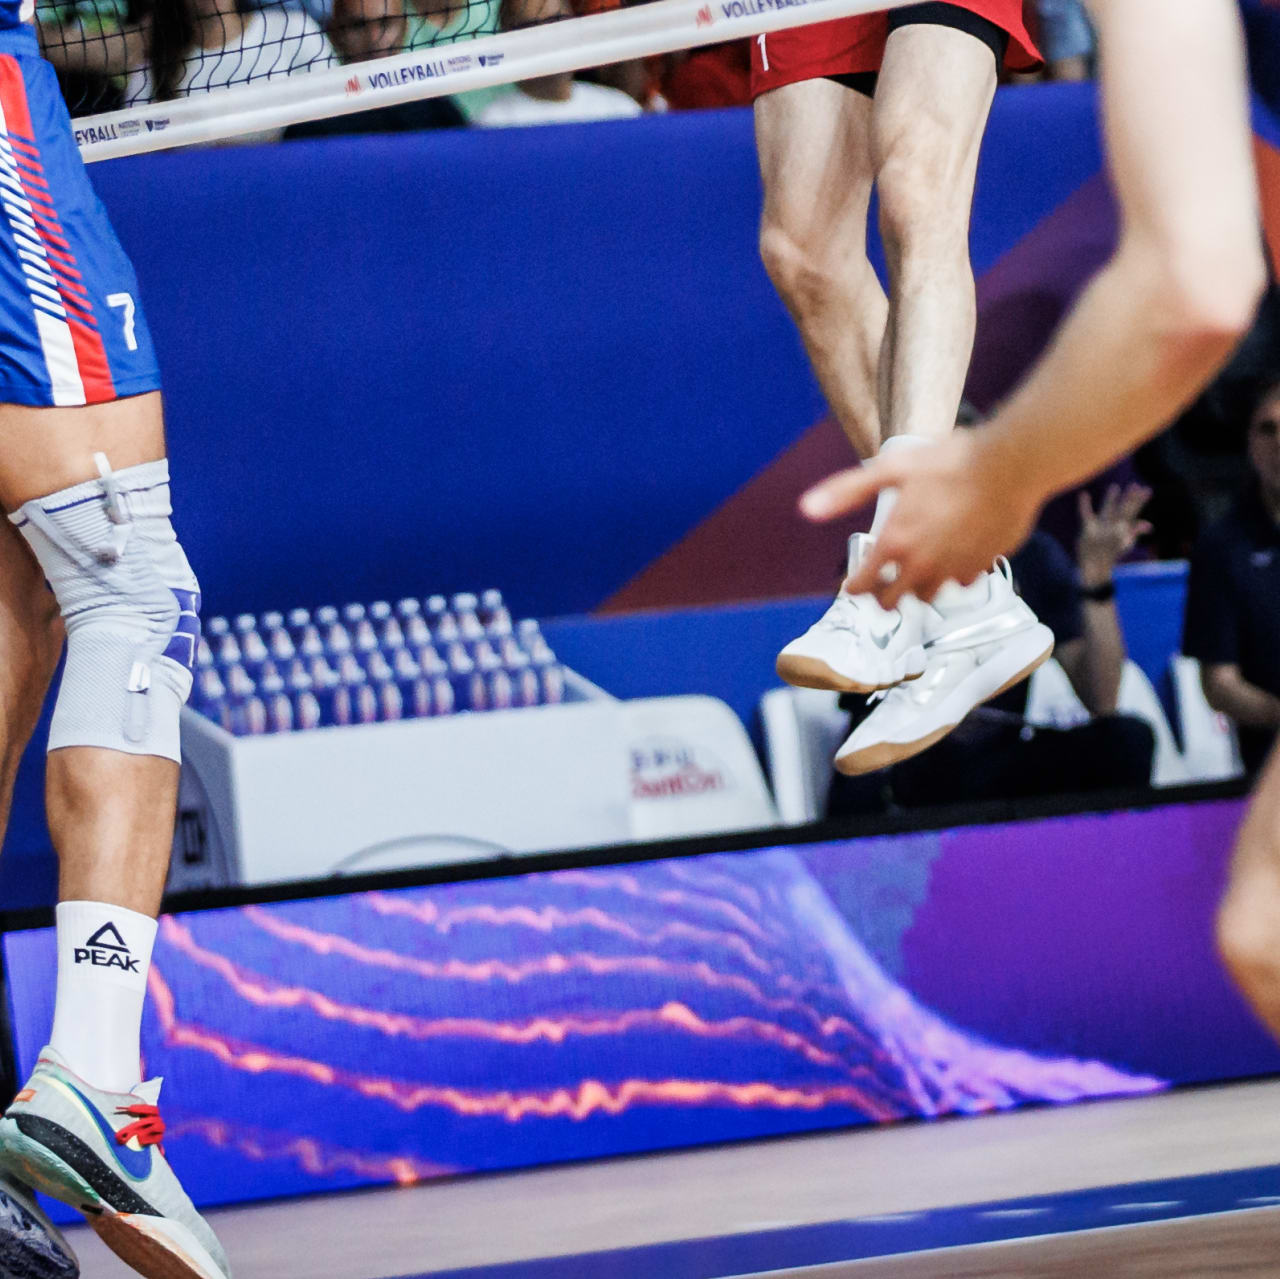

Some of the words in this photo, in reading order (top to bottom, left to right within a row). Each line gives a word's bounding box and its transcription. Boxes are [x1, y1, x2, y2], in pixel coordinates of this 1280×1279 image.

[368, 61, 446, 89] VOLLEYBALL
[74, 124, 118, 146] EYBALL
[106, 292, 138, 351] 7
[73, 947, 141, 974] PEAK
